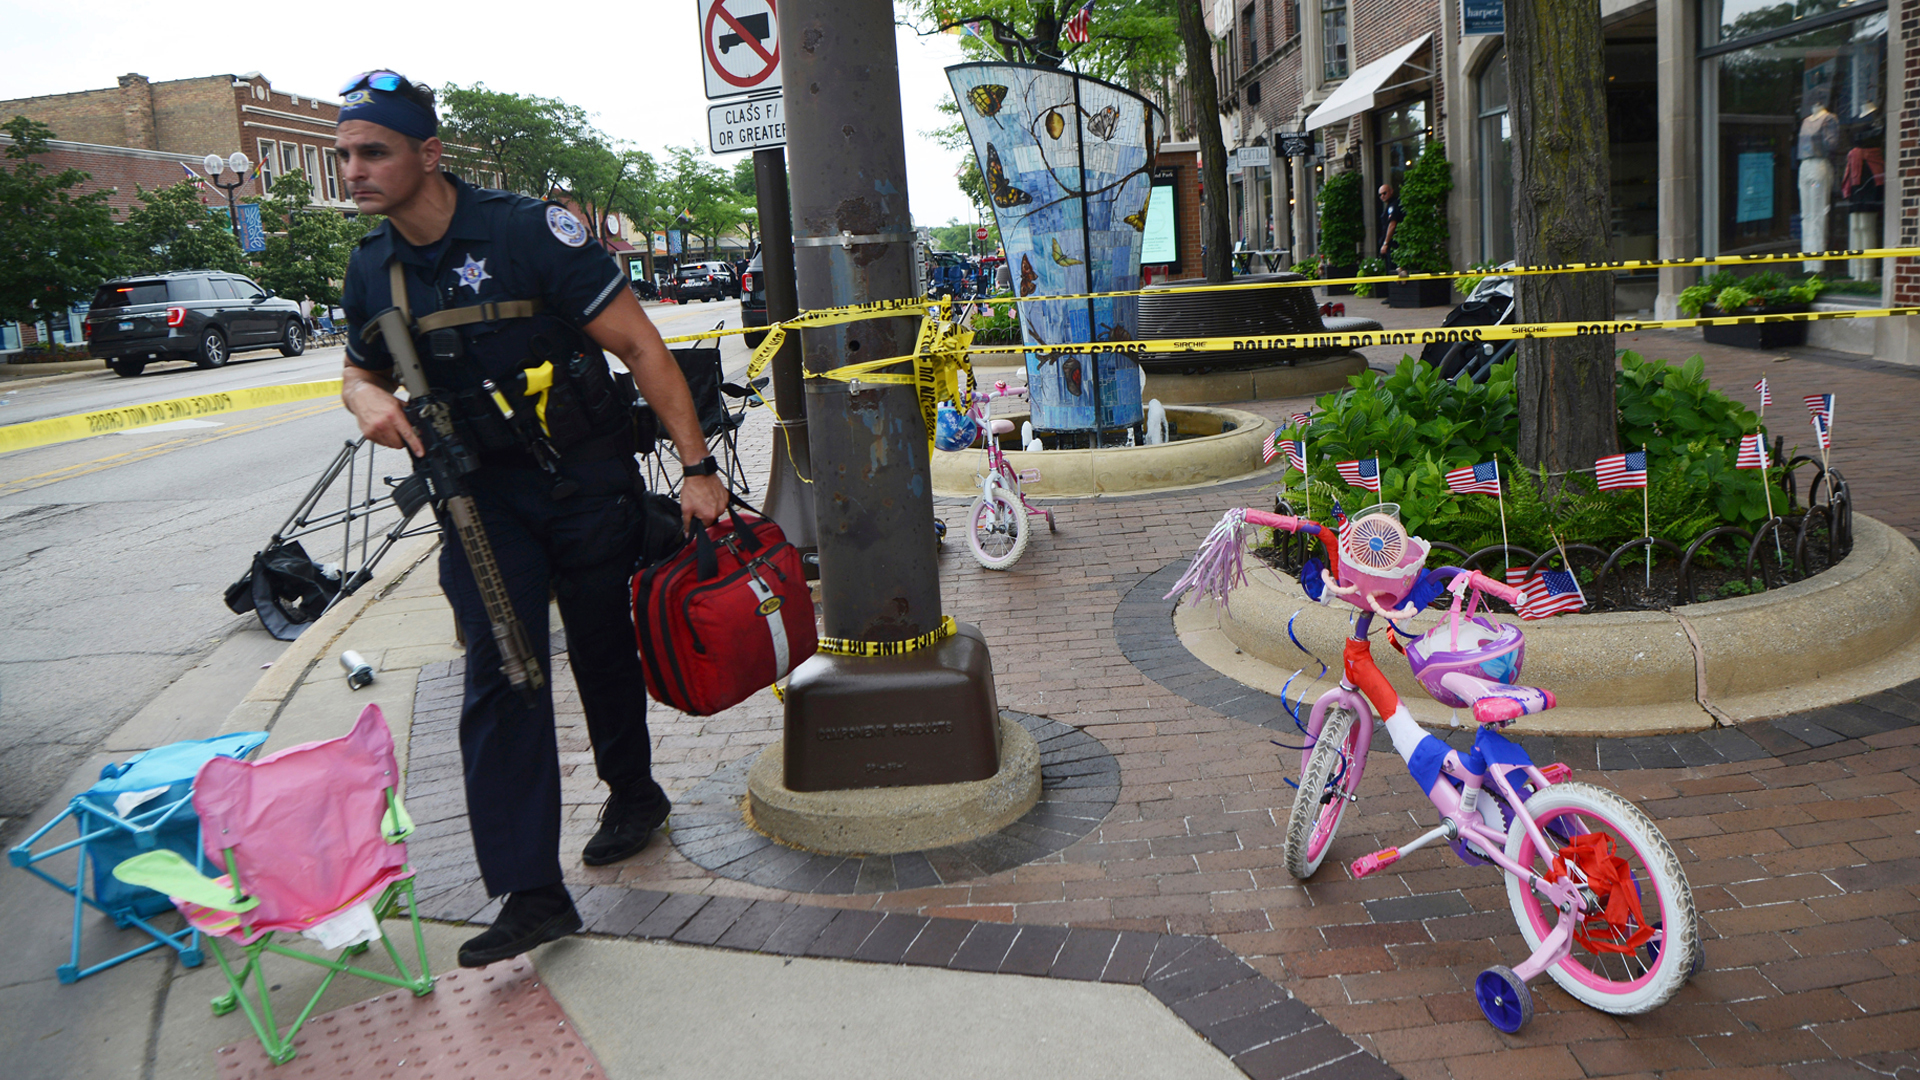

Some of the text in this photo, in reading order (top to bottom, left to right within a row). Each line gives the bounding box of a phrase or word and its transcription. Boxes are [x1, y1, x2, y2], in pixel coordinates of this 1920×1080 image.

[1466, 7, 1499, 19] harper
[725, 106, 761, 125] CLASS
[719, 130, 734, 146] OR
[1239, 147, 1269, 161] CENTRAL
[1380, 332, 1415, 345] NOT
[817, 720, 953, 741] COMPONENT PRODUCTS
